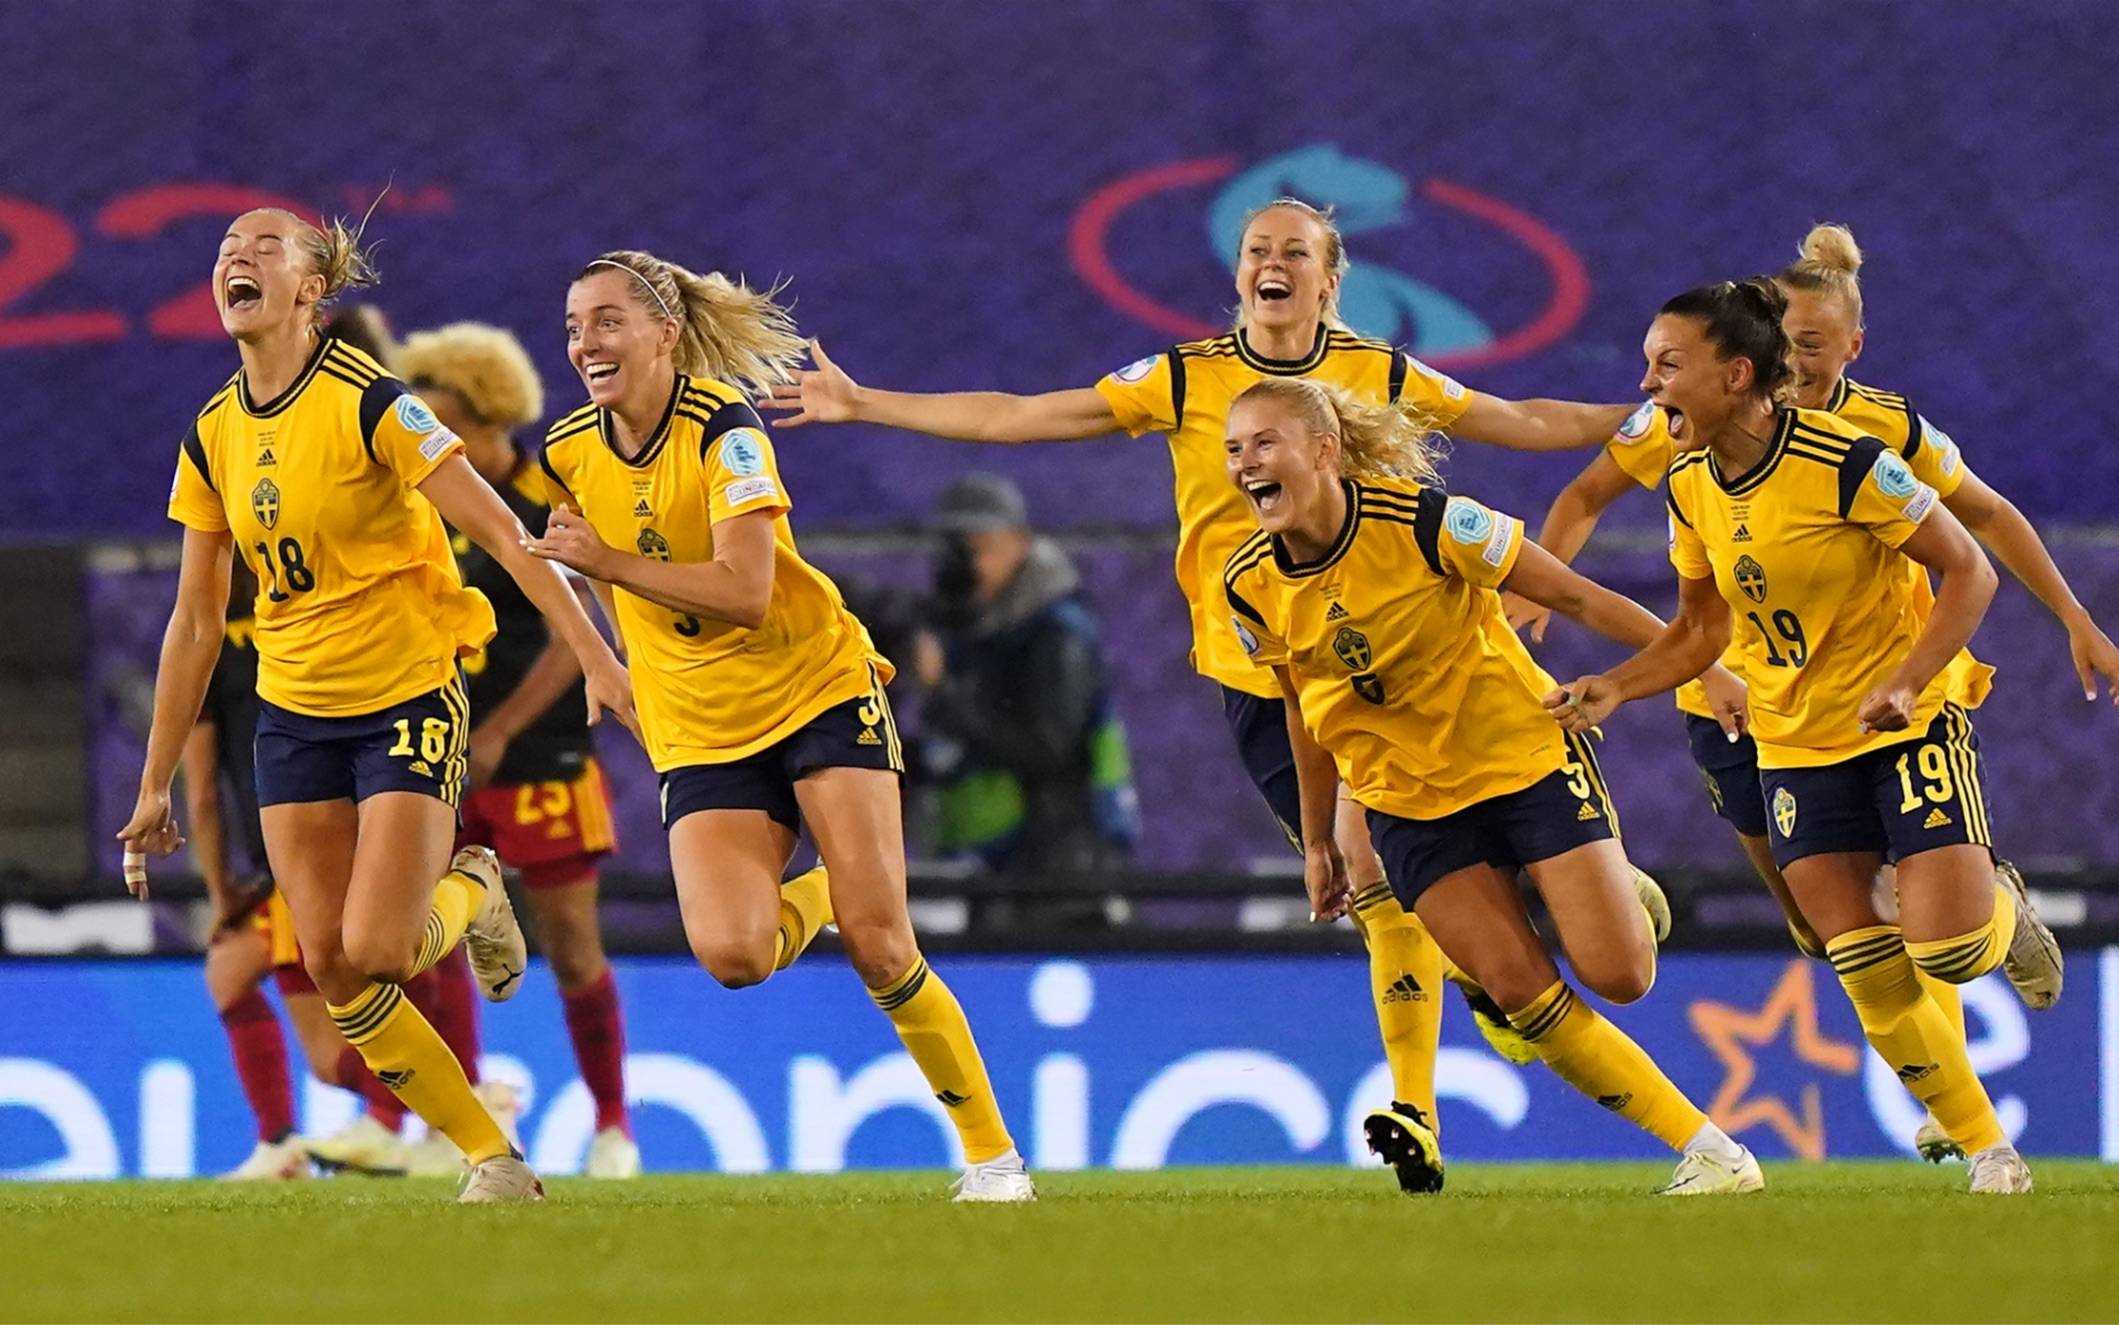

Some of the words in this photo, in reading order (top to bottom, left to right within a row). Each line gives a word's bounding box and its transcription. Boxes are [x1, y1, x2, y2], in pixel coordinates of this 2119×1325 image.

[255, 537, 315, 602] 18
[1747, 609, 1808, 668] 19
[388, 717, 450, 764] 18
[1896, 744, 1953, 814] 19
